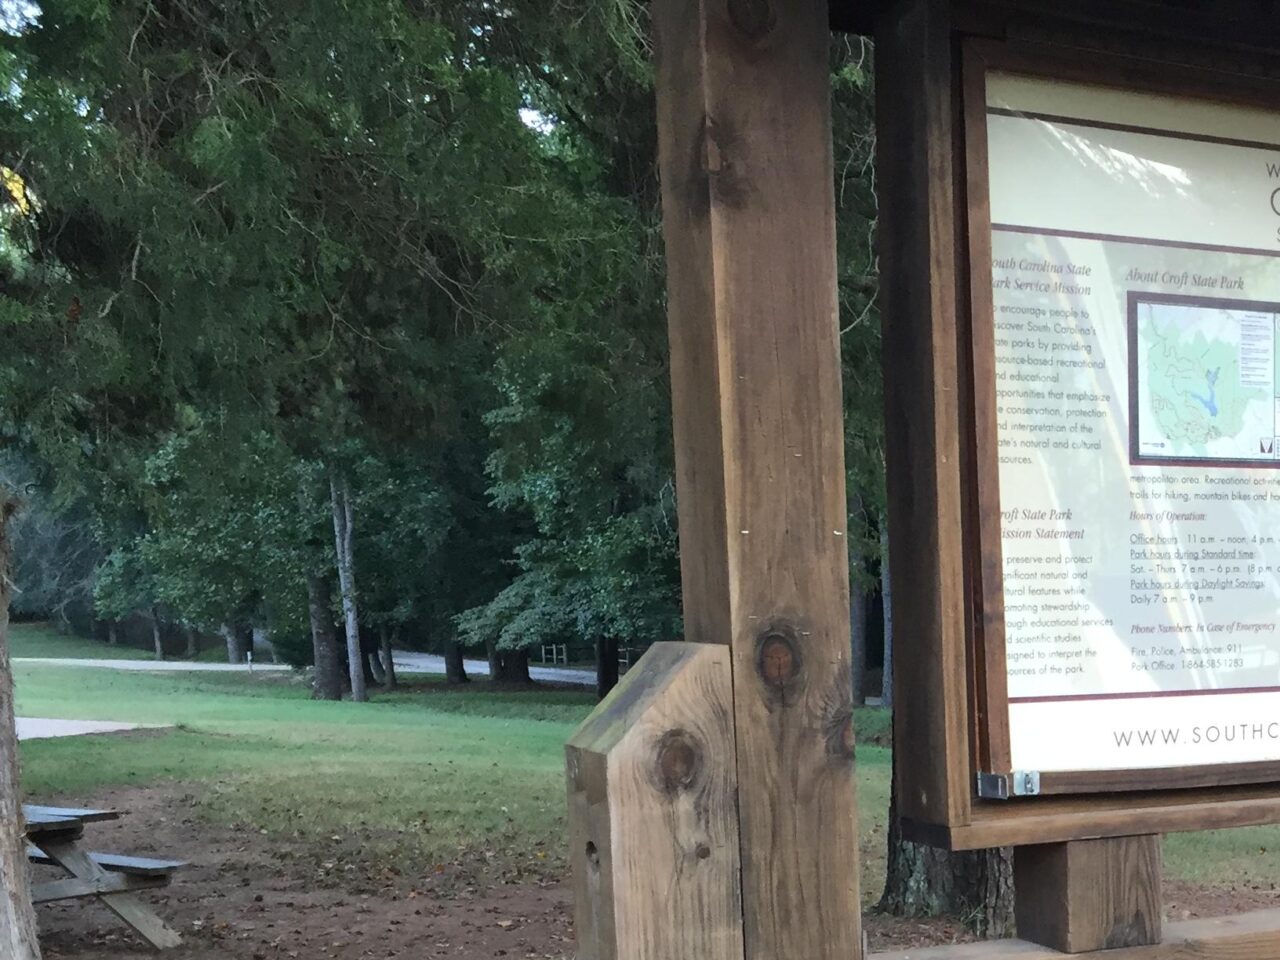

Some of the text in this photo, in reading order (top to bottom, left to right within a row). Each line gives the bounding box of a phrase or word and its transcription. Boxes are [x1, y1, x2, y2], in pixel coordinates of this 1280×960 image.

[992, 257, 1092, 276] outh Carolina State
[1125, 267, 1245, 289] About Croft State Park
[991, 276, 1091, 295] ark Service Mission
[1000, 305, 1046, 318] encourage
[1049, 307, 1079, 320] people
[1027, 321, 1051, 333] South
[1011, 338, 1035, 350] parks
[1051, 341, 1092, 354] providing
[1056, 358, 1106, 369] recreational
[1009, 371, 1059, 383] educational
[996, 388, 1111, 403] pportunities that emphasize
[1066, 408, 1107, 419] protection
[1010, 421, 1066, 433] interpretation
[998, 437, 1101, 449] ate's natural and cultural
[1130, 490, 1148, 499] trails
[1194, 491, 1229, 500] mountain
[1231, 492, 1251, 500] bikes
[1253, 492, 1267, 501] and
[1000, 508, 1073, 523] roft State Park
[1129, 511, 1154, 520] Hours
[1001, 529, 1085, 538] ission Statement
[1129, 533, 1155, 543] Office
[1130, 549, 1146, 558] Park
[1150, 549, 1171, 558] hours
[1175, 549, 1198, 560] during
[1202, 549, 1236, 558] Standard
[1006, 558, 1043, 566] preserve
[1065, 556, 1093, 565] protect
[1040, 571, 1068, 579] natural
[1072, 570, 1088, 579] and
[1131, 579, 1147, 588] Park
[1150, 579, 1171, 588] hours
[1175, 579, 1199, 590] during
[1202, 578, 1233, 590] Daylight
[1028, 587, 1060, 595] features
[1064, 587, 1086, 595] while
[1130, 594, 1150, 605] Daily
[1005, 602, 1090, 614] omoting stewardship
[1030, 618, 1078, 627] educational
[1081, 617, 1113, 626] services
[1131, 625, 1155, 634] Phone
[1206, 623, 1224, 632] Case
[1236, 622, 1276, 633] Emergency
[1015, 634, 1051, 643] scientific
[1054, 634, 1081, 642] studies
[1227, 644, 1242, 653] 911
[1048, 649, 1082, 660] interpret
[1131, 661, 1149, 671] Park
